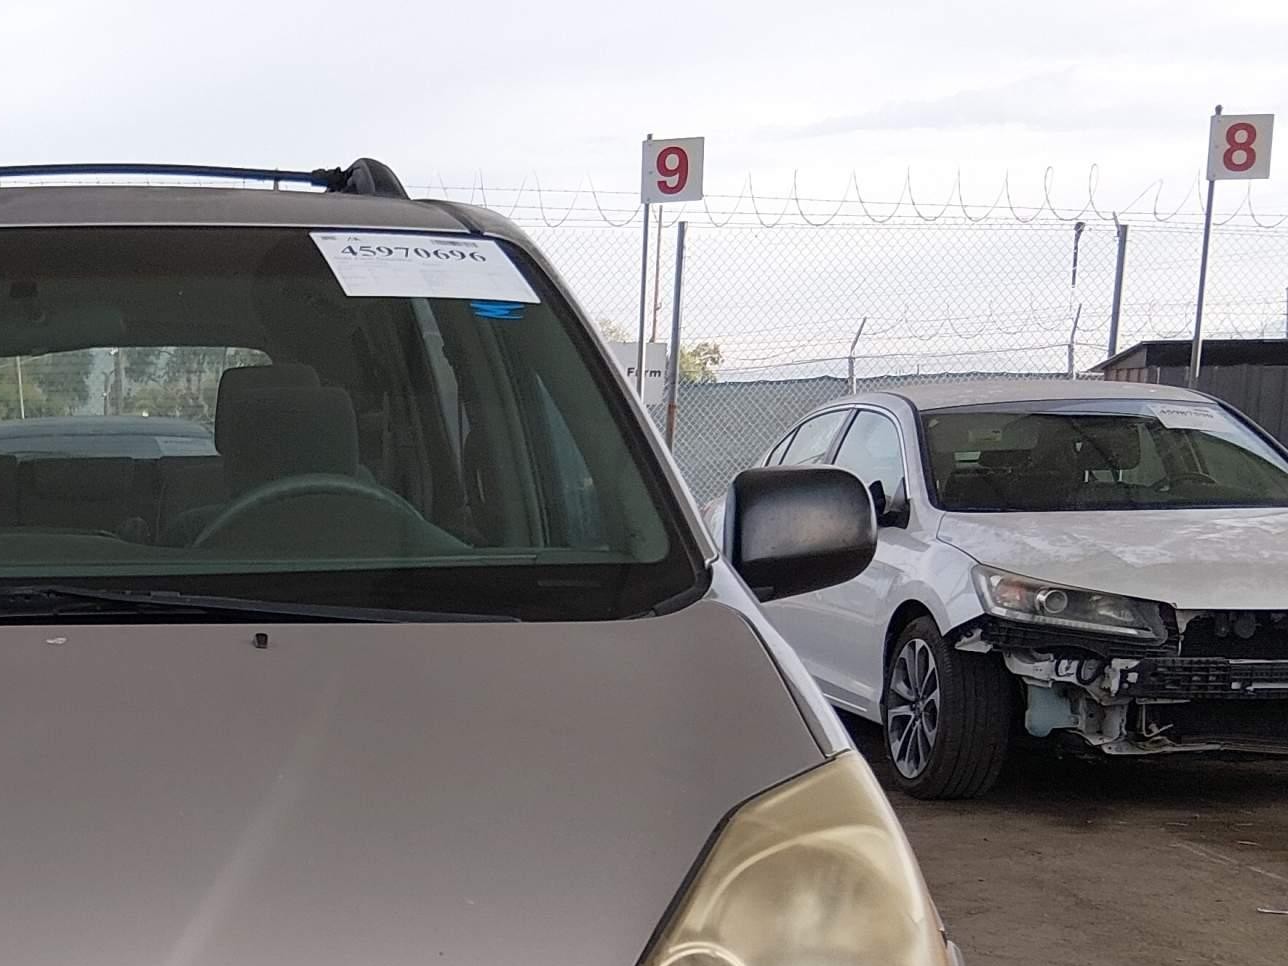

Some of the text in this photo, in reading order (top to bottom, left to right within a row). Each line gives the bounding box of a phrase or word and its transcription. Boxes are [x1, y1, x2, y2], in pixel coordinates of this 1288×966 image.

[656, 146, 689, 195] 9
[1223, 122, 1257, 172] 8
[341, 244, 487, 263] 45970696
